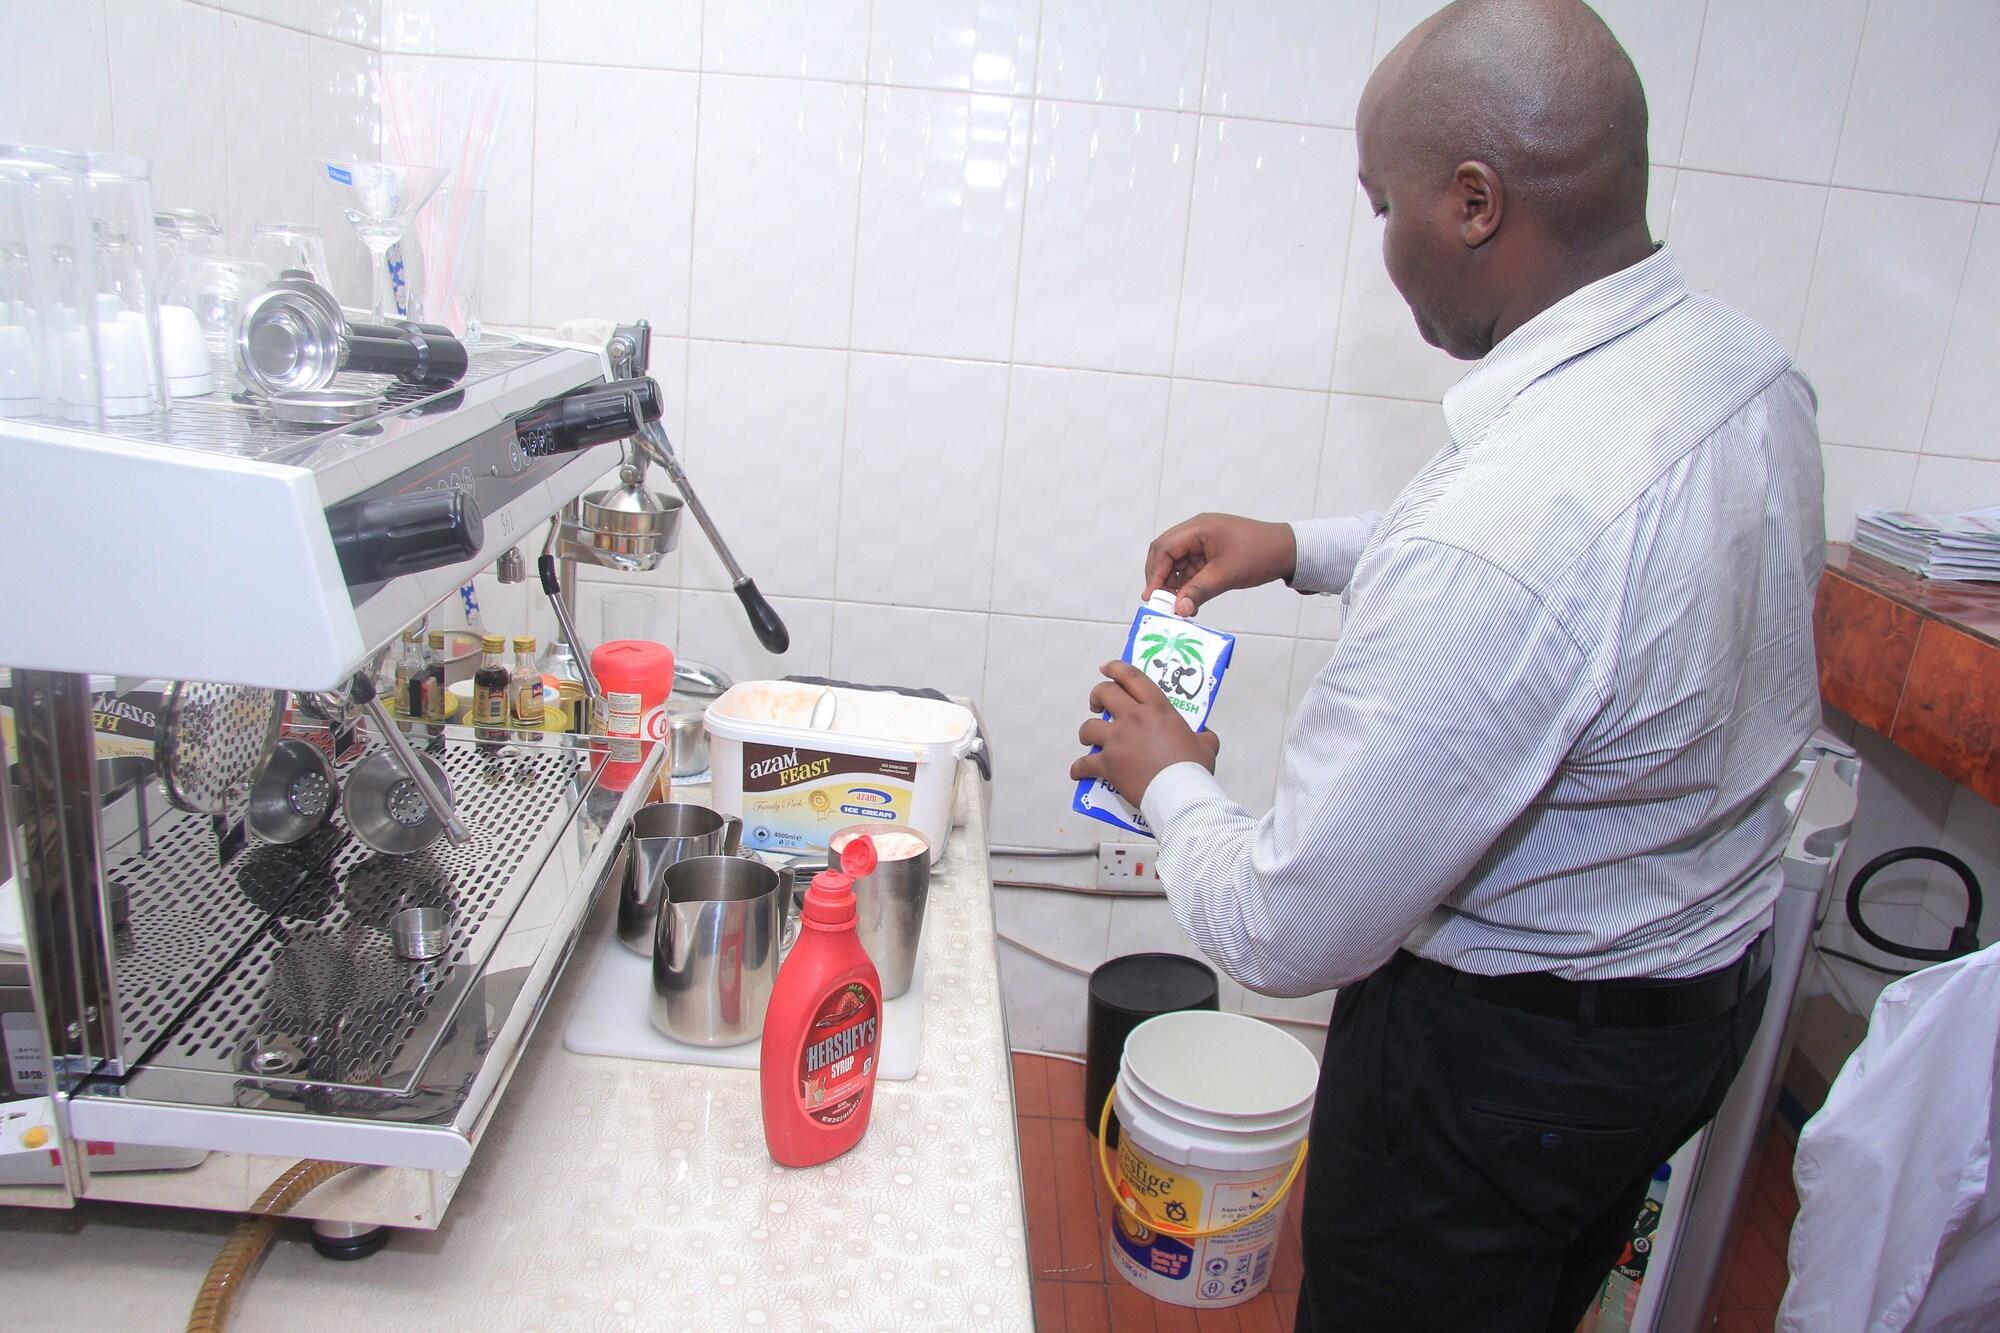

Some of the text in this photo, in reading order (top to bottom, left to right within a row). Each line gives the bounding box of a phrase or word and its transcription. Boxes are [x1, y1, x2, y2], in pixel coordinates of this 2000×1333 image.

[856, 792, 877, 804] azam
[844, 806, 892, 819] ICE CREAM
[807, 1017, 876, 1072] HERSHEY'S
[831, 1055, 855, 1079] SYRUP
[1620, 1265, 1641, 1278] TWIST
